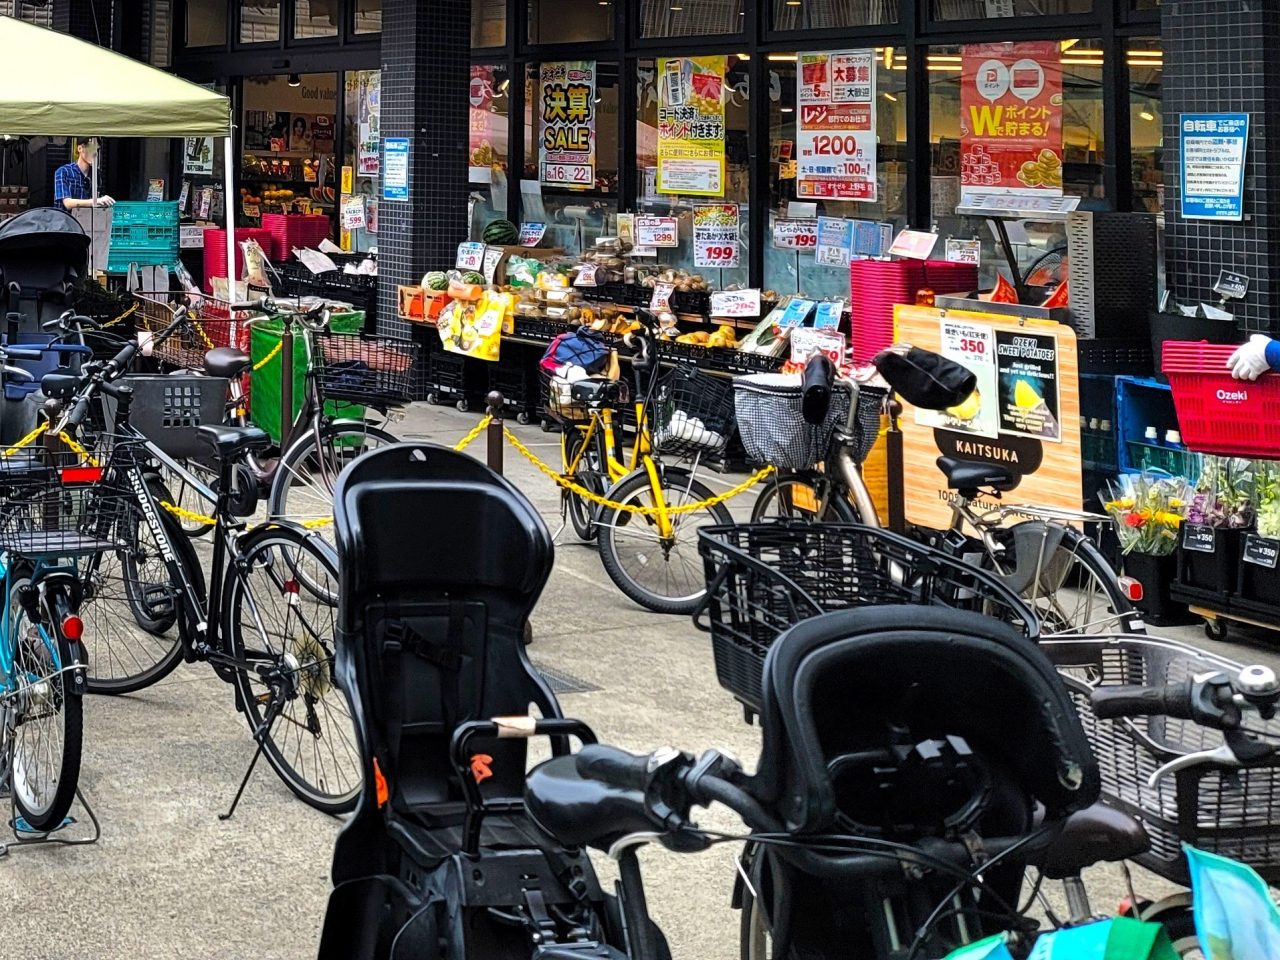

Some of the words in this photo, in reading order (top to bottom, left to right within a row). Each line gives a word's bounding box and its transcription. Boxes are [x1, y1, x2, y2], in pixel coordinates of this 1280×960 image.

[833, 66, 869, 83] 大募集
[543, 84, 590, 121] 決算
[804, 106, 827, 124] レジ
[1005, 105, 1052, 120] ポイント
[1183, 119, 1217, 132] 自転車
[544, 127, 590, 151] SALE
[812, 135, 857, 156] 1200
[779, 226, 815, 234] じゃがいも
[653, 234, 672, 242] 1299
[705, 247, 733, 260] 199
[959, 339, 985, 354] 350
[1012, 337, 1037, 348] OZEKI
[998, 343, 1021, 357] SWEET
[1021, 346, 1055, 362] POTATOES
[1216, 390, 1248, 401] Ozeki
[956, 440, 1019, 463] KAITSUKA
[127, 468, 175, 563] BRIDGESTONE
[1197, 534, 1213, 542] ¥350
[1258, 548, 1276, 557] ¥350
